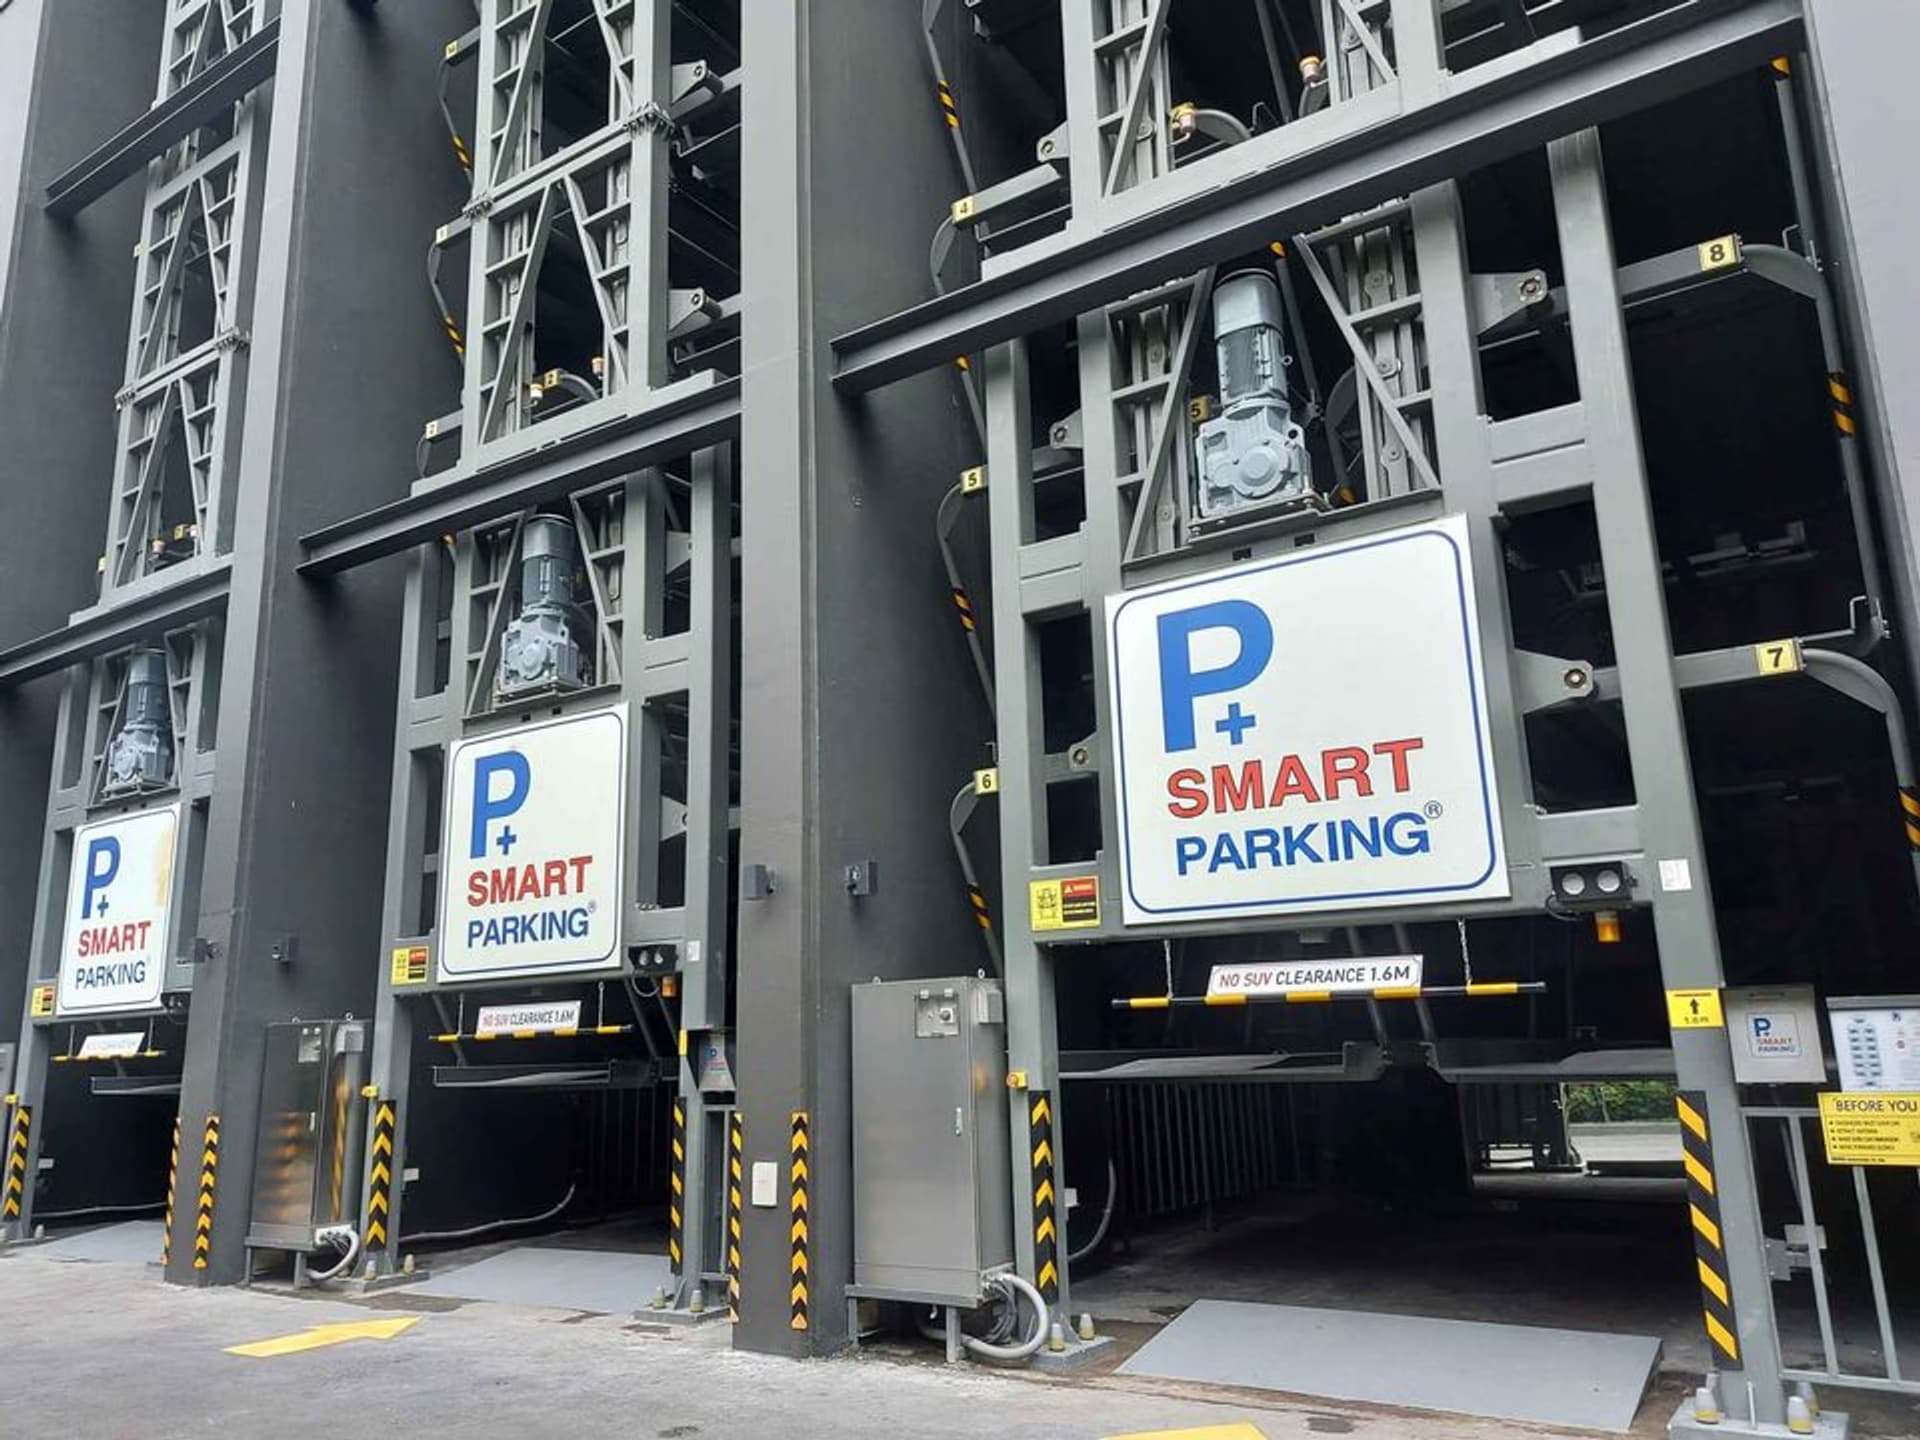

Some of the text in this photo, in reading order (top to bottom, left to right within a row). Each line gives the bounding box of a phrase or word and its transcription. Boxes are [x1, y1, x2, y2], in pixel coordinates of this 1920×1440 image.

[1710, 243, 1725, 262] 8
[968, 471, 978, 487] 5
[1766, 646, 1783, 668] 7
[982, 773, 992, 789] 6
[1167, 738, 1424, 819] SMART
[467, 855, 593, 907] SMART
[78, 921, 151, 957] SMART
[75, 960, 146, 989] PARKING
[1219, 965, 1411, 988] NO SUV CLEARANCE 1.6M
[1836, 1100, 1918, 1113] BEFORE YOU
